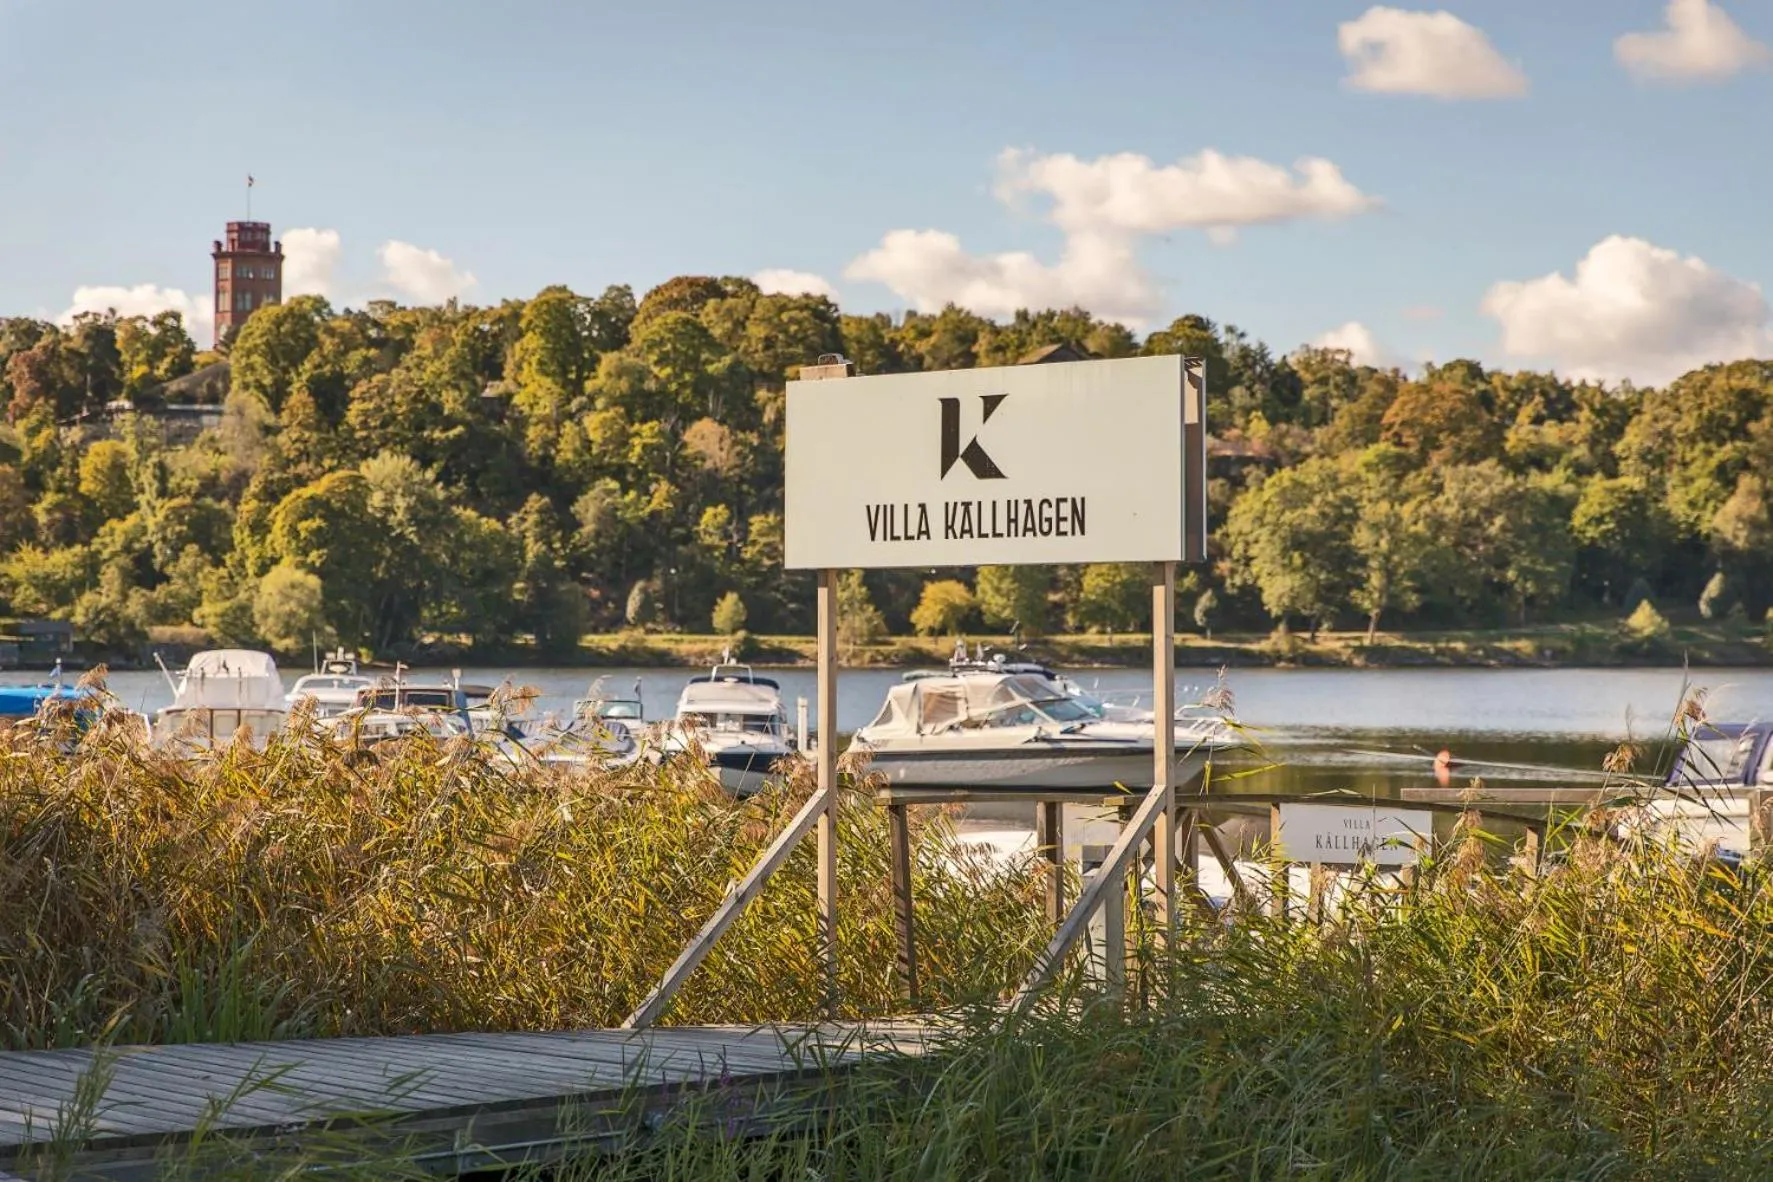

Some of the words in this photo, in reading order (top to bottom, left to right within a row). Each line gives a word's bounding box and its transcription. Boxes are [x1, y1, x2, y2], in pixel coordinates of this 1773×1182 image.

[938, 393, 1009, 480] K
[866, 503, 931, 542] VILLA
[1343, 819, 1371, 830] VILLA
